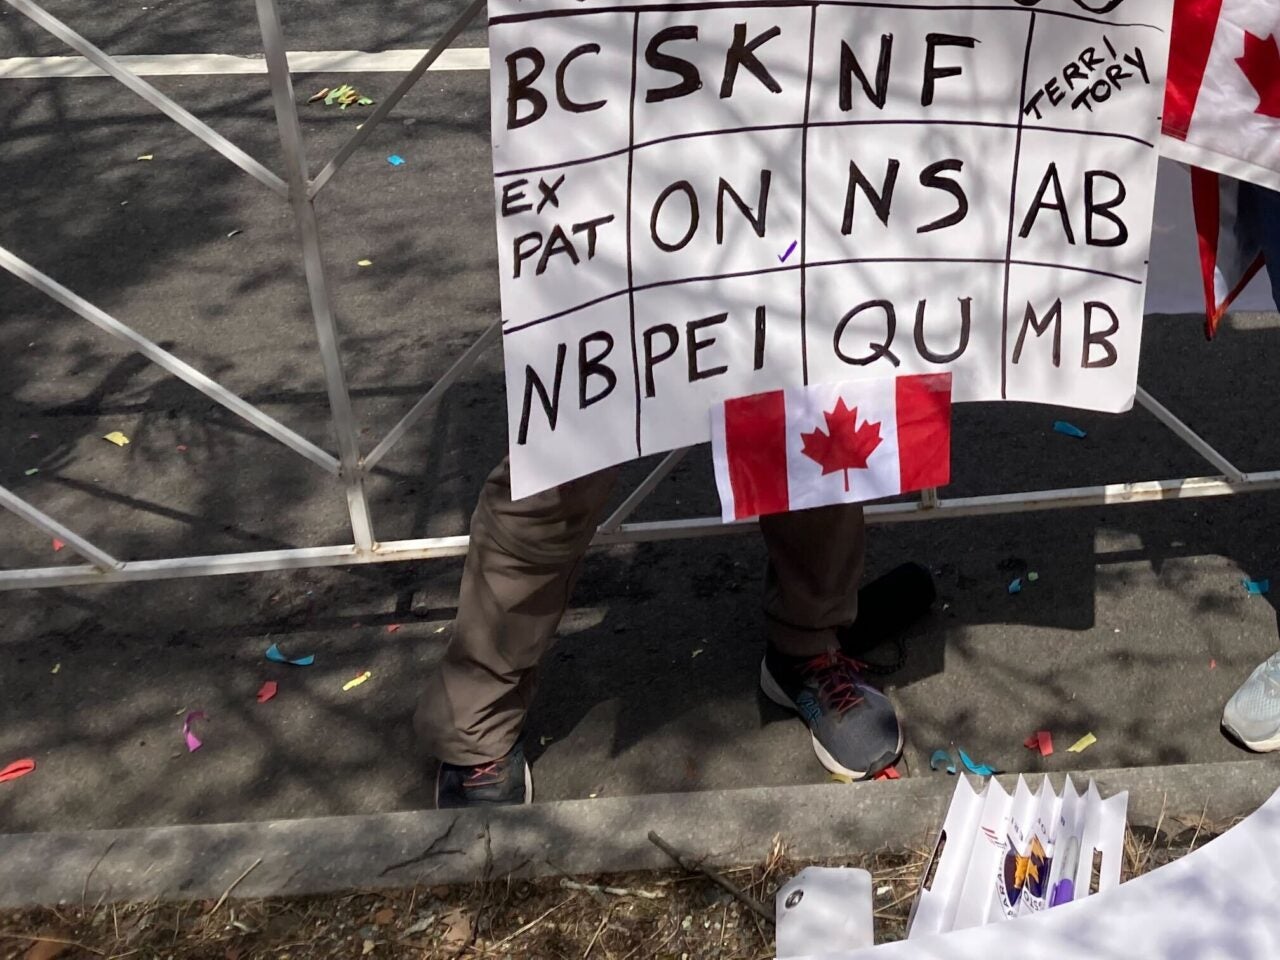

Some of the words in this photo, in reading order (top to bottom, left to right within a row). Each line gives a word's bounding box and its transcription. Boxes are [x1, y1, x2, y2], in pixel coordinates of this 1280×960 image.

[504, 42, 608, 130] BC
[644, 23, 783, 104] SK
[838, 32, 982, 112] NF
[1023, 34, 1118, 120] TERRI
[1071, 46, 1150, 113] TORY
[501, 174, 568, 217] EX
[649, 169, 772, 252] ON
[841, 158, 970, 236] NS
[1018, 161, 1129, 247] AB
[513, 214, 615, 278] PAT
[643, 304, 766, 399] PEI
[832, 295, 973, 367] QU
[1011, 298, 1120, 368] MB
[517, 330, 618, 445] NB
